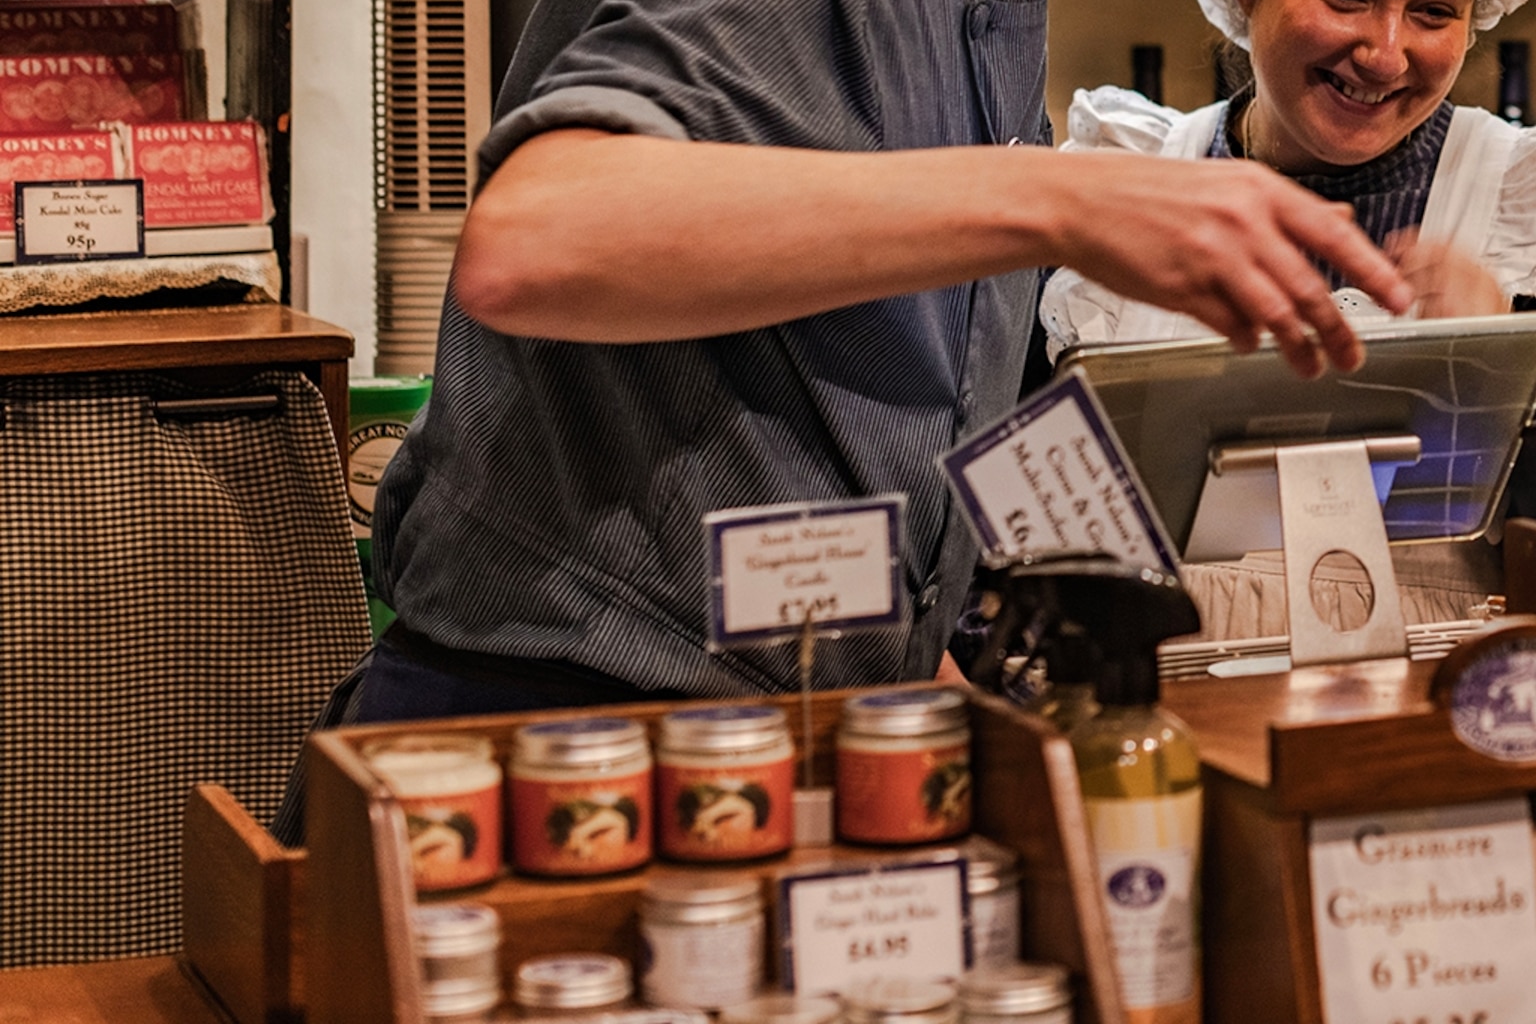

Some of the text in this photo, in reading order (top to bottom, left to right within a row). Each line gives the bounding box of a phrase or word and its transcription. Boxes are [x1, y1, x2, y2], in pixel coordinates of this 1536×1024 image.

[0, 136, 107, 153] OMNEY'S
[146, 181, 188, 196] ENDAL
[66, 235, 96, 251] 95p
[1353, 824, 1494, 865] Grasmere
[1371, 948, 1498, 991] 6 Pieces
